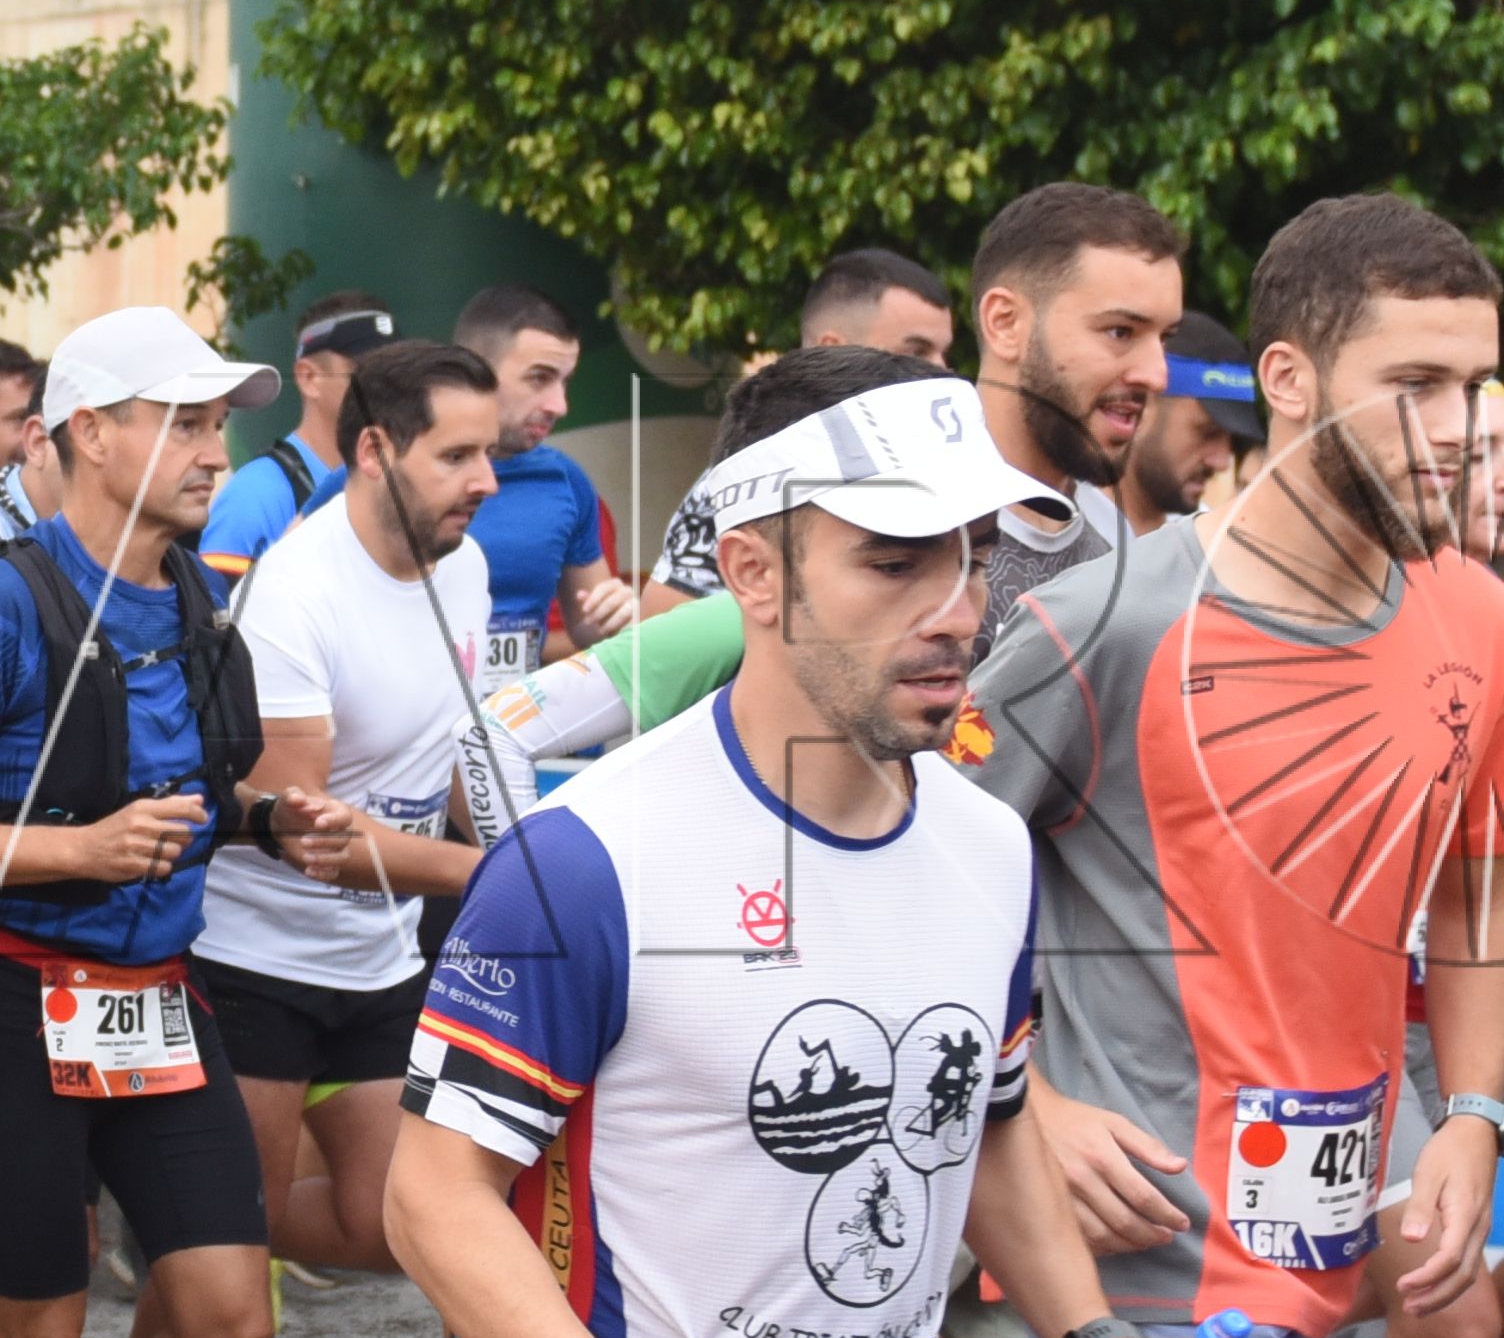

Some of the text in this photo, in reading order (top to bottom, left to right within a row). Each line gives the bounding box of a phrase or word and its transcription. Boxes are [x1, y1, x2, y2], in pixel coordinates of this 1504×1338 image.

[486, 636, 519, 666] 30
[96, 992, 145, 1035] 261
[55, 1037, 64, 1052] 2
[52, 1061, 93, 1087] 32K
[1309, 1126, 1368, 1188] 421
[1245, 1188, 1259, 1209] 3
[1233, 1221, 1300, 1258] 16K
